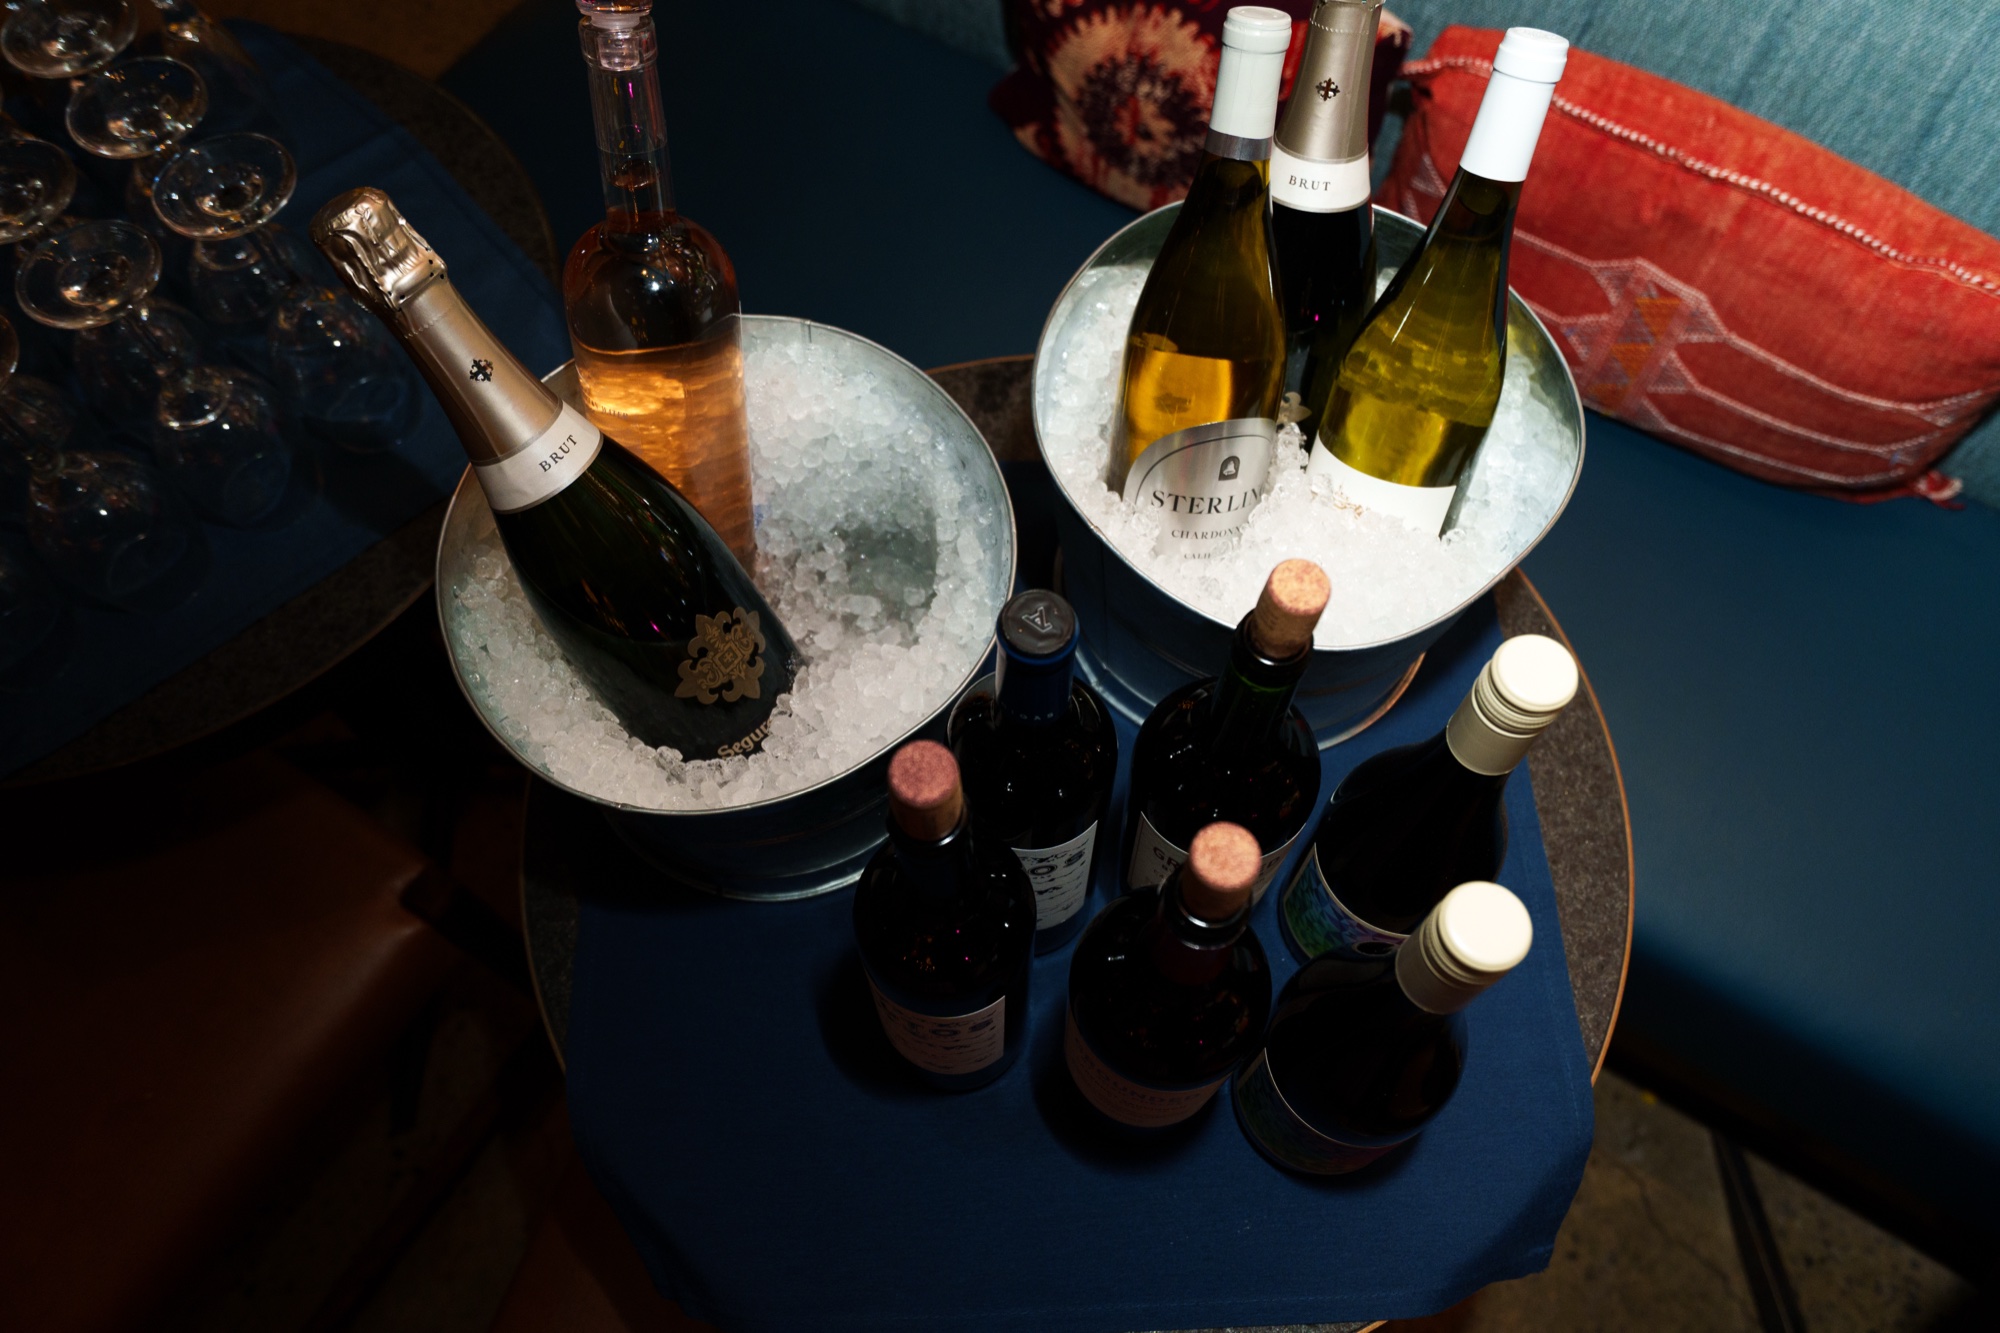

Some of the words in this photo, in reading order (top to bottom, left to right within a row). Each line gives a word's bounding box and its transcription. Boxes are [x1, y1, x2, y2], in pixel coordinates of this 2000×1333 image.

[1289, 174, 1332, 192] BRUT
[538, 434, 578, 473] BRUT
[1150, 486, 1264, 515] STERLIN
